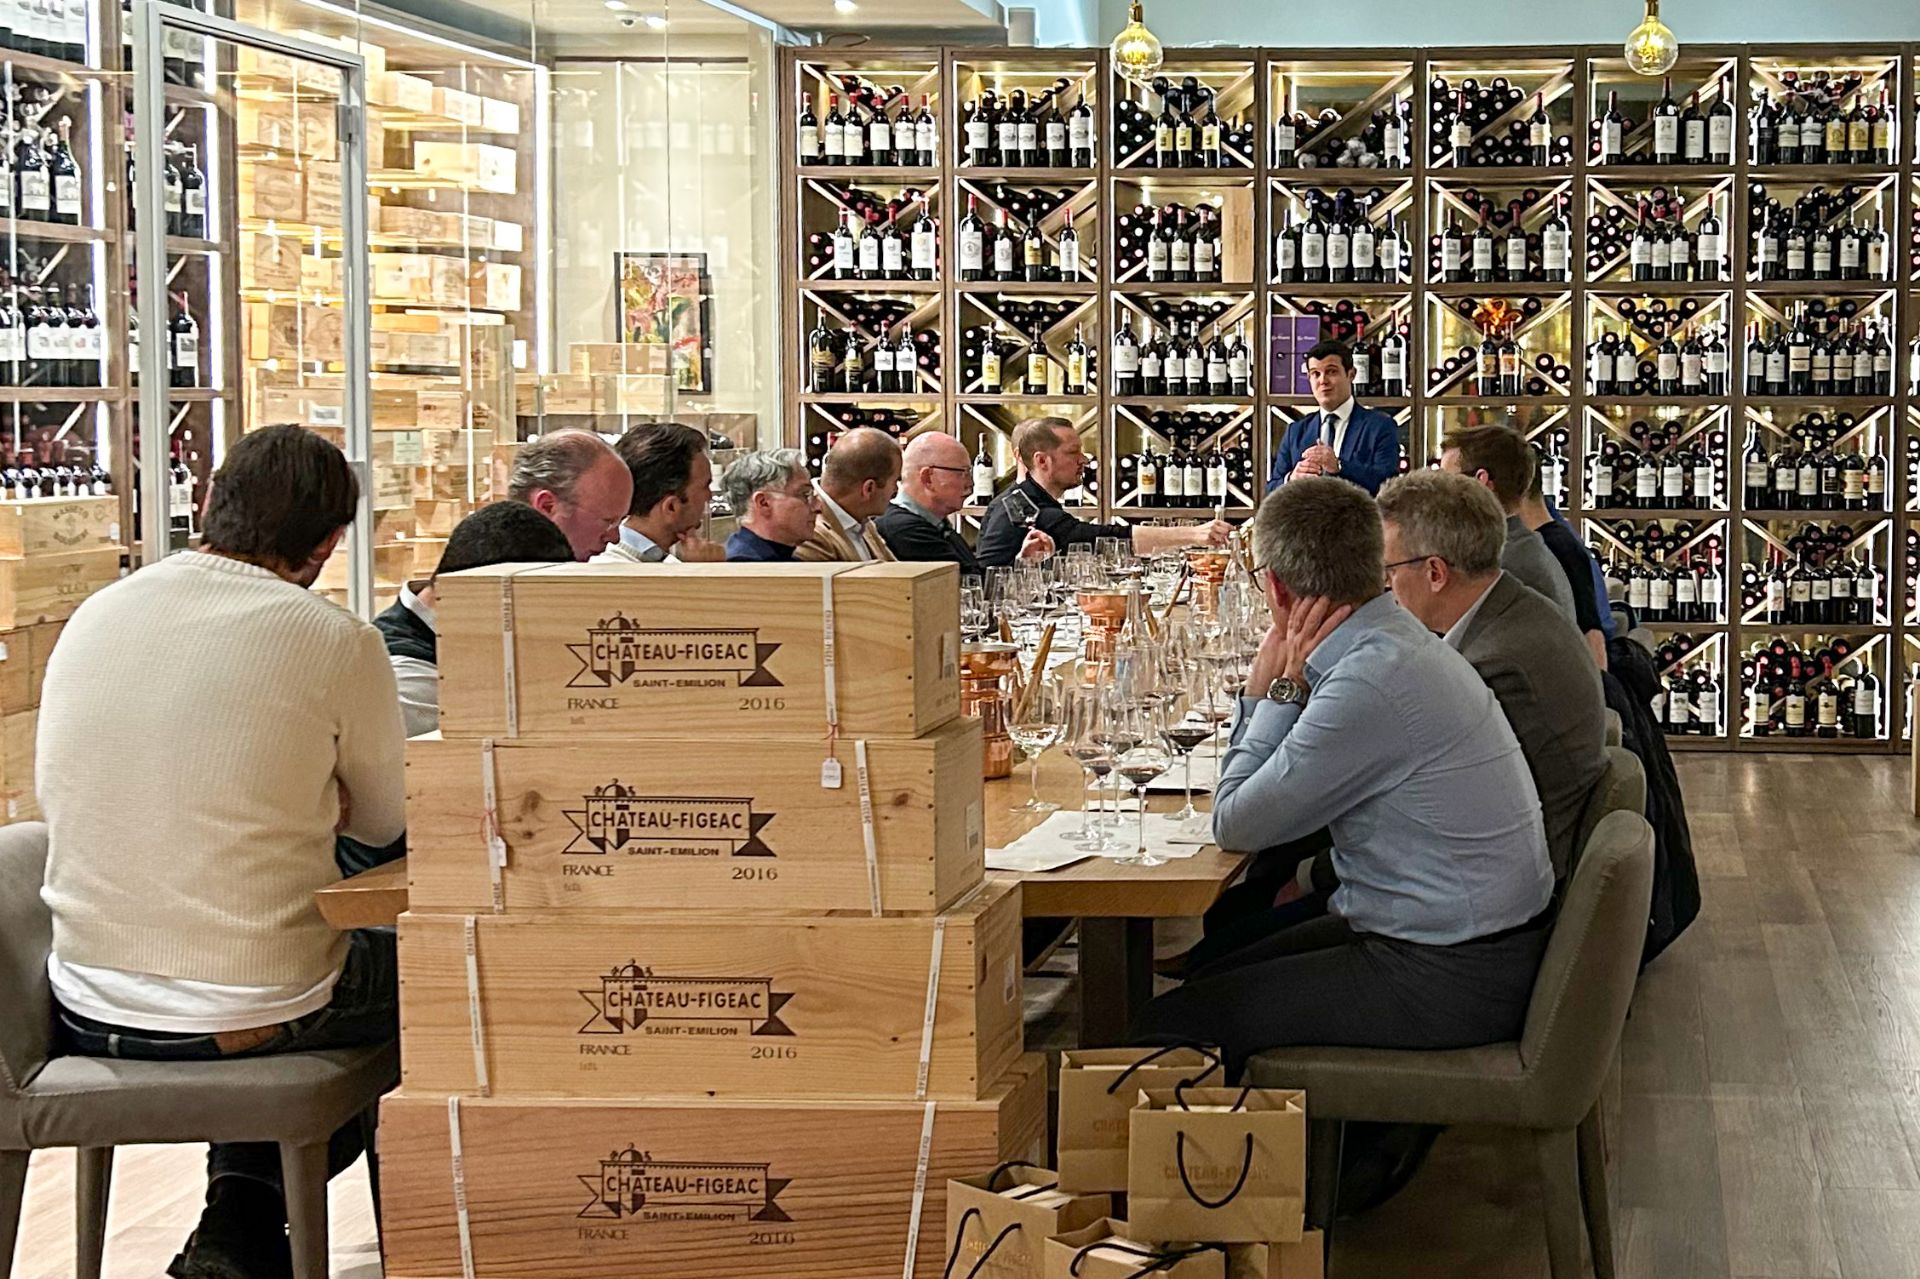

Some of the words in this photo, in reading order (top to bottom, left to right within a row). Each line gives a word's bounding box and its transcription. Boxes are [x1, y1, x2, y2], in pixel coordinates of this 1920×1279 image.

[595, 643, 749, 660] CHATEAU-FIGEAC
[633, 679, 726, 688] SAINT-EMILION
[567, 698, 620, 710] FRANCE
[738, 697, 786, 711] 2016
[591, 811, 743, 829] CHATEAU-FIGEAC
[627, 847, 720, 856] SAINT-EMILION
[562, 864, 615, 877] FRANCE
[731, 867, 778, 881] 2016
[608, 991, 762, 1009] CHATEAU-FIGEAC
[645, 1026, 739, 1036] SAINT-EMILION
[579, 1043, 632, 1056] FRANCE
[751, 1046, 798, 1059] 2016
[606, 1176, 759, 1194] CHATEAU-FIGEAC
[643, 1211, 736, 1221] SAINT-EMILION
[577, 1228, 630, 1240] FRANCE
[748, 1232, 796, 1245] 2016
